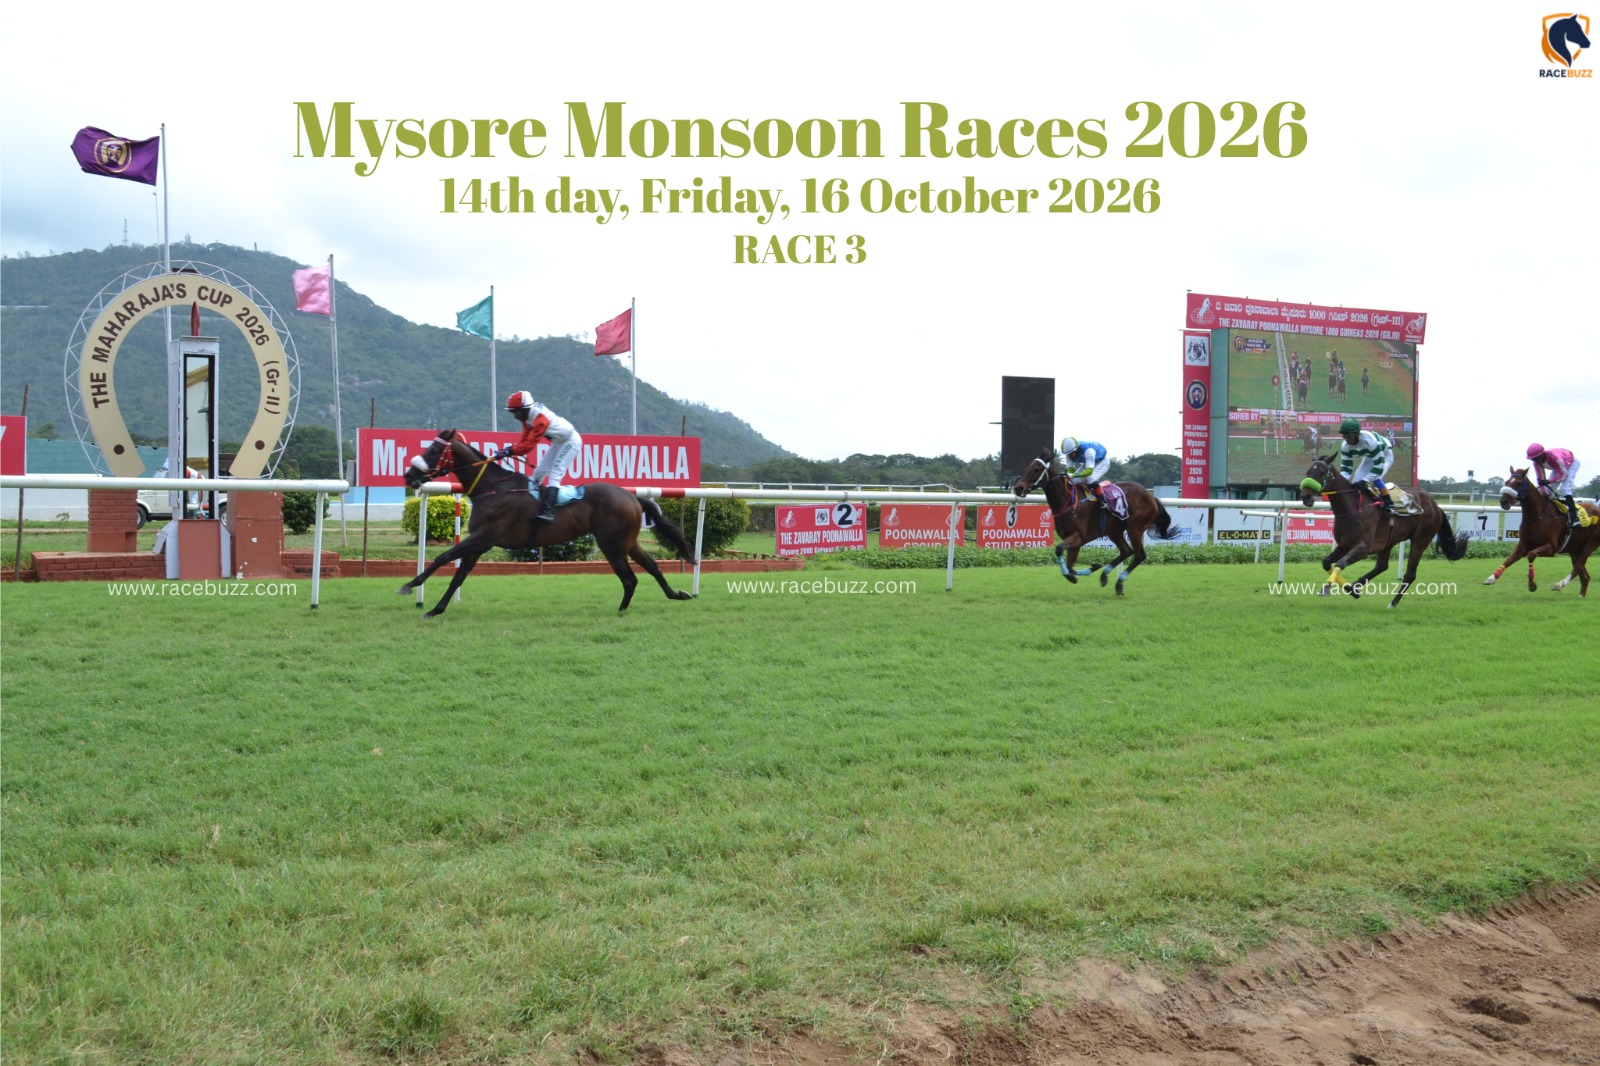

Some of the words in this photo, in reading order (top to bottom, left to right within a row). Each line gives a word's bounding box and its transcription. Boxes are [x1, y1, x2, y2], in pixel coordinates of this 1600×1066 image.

[197, 285, 233, 308] CUP
[91, 283, 187, 363] MAHARAJA'S
[235, 307, 270, 346] 2026
[1309, 309, 1326, 320] 1000
[1350, 312, 1369, 323] 2026
[1219, 317, 1230, 327] THE
[1260, 321, 1299, 333] POONAWALLA
[1301, 324, 1324, 335] MYSORE
[1325, 327, 1339, 336] 1000
[1340, 328, 1364, 338] GUINEAS
[90, 372, 110, 409] THE
[1186, 439, 1206, 447] Mysore
[537, 443, 690, 480] PONAWALLA
[1186, 458, 1206, 466] Guineas
[837, 504, 853, 526] 2
[1008, 506, 1016, 527] 3
[1478, 516, 1488, 531] 7
[780, 532, 793, 545] THE
[793, 530, 821, 545] ZAVARAY
[822, 529, 864, 543] POONAWALLA
[982, 528, 1050, 540] POONAWALLA
